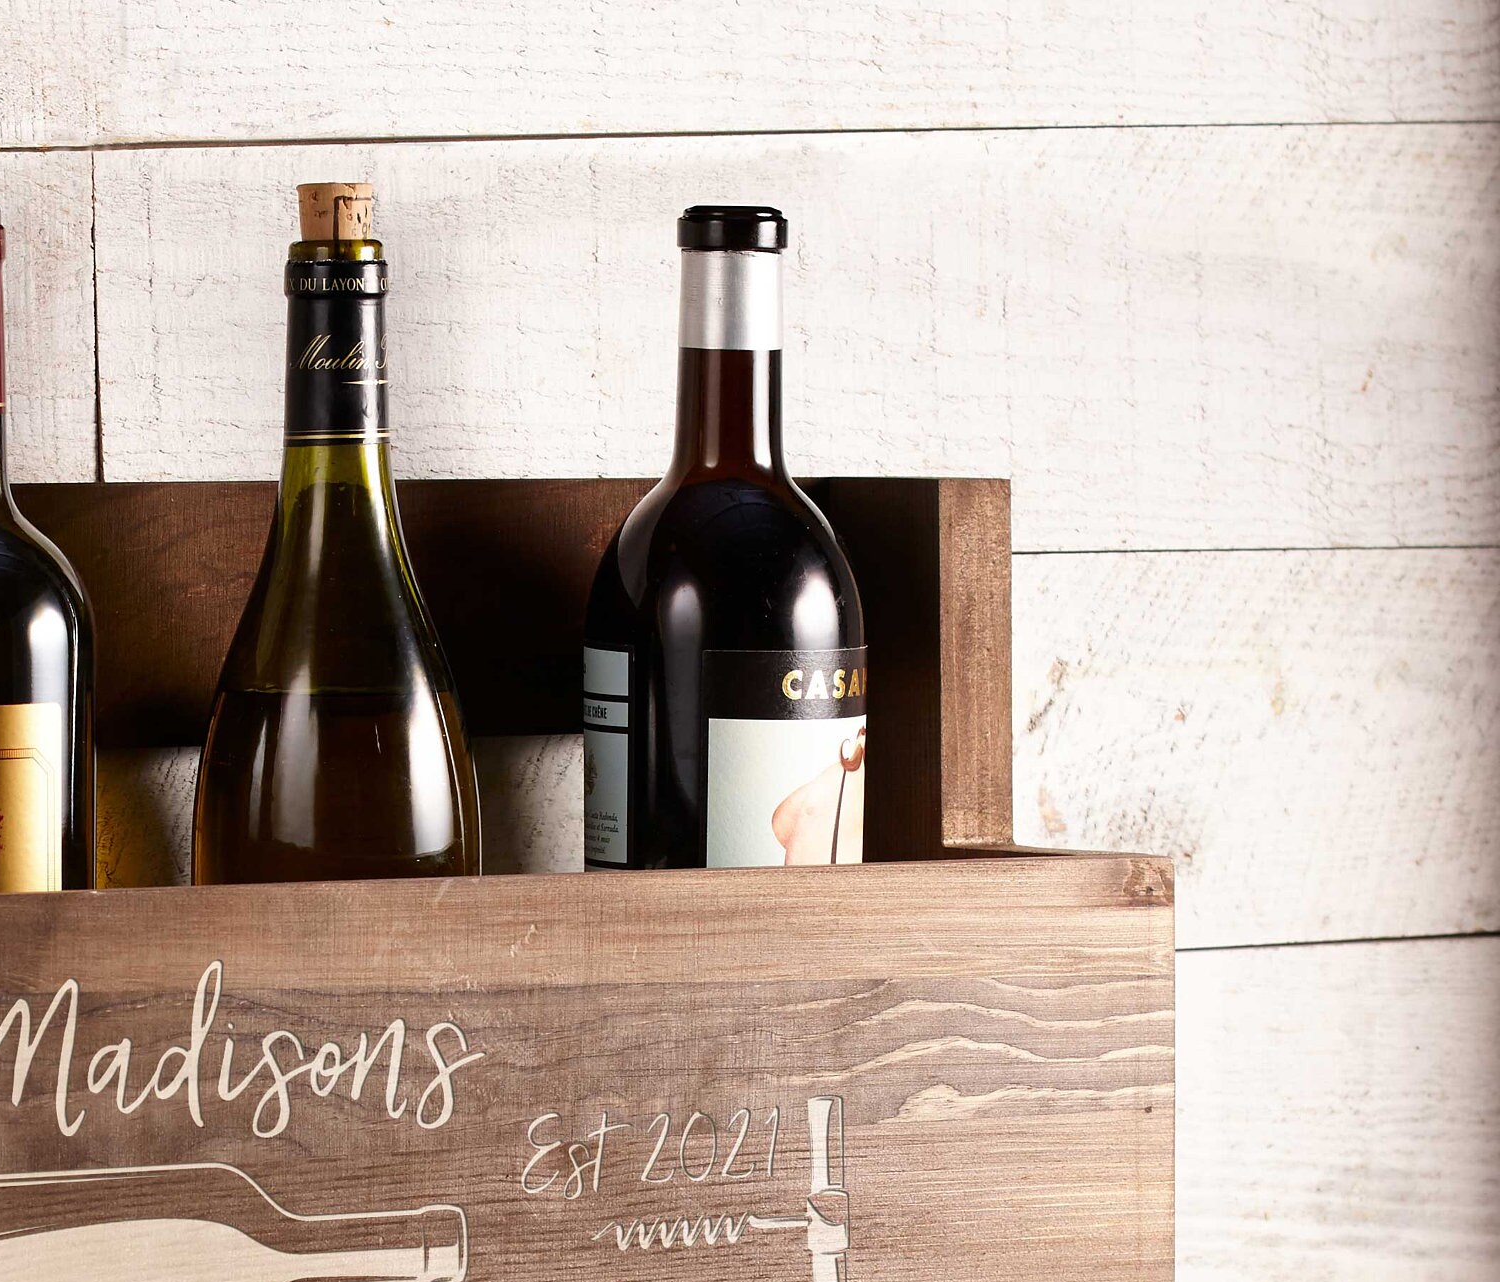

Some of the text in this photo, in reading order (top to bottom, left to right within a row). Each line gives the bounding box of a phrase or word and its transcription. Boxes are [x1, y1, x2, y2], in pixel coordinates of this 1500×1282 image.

[300, 278, 317, 291] DU
[322, 277, 365, 291] LAYON
[289, 334, 370, 370] Moulin
[521, 1104, 780, 1200] Est 2021
